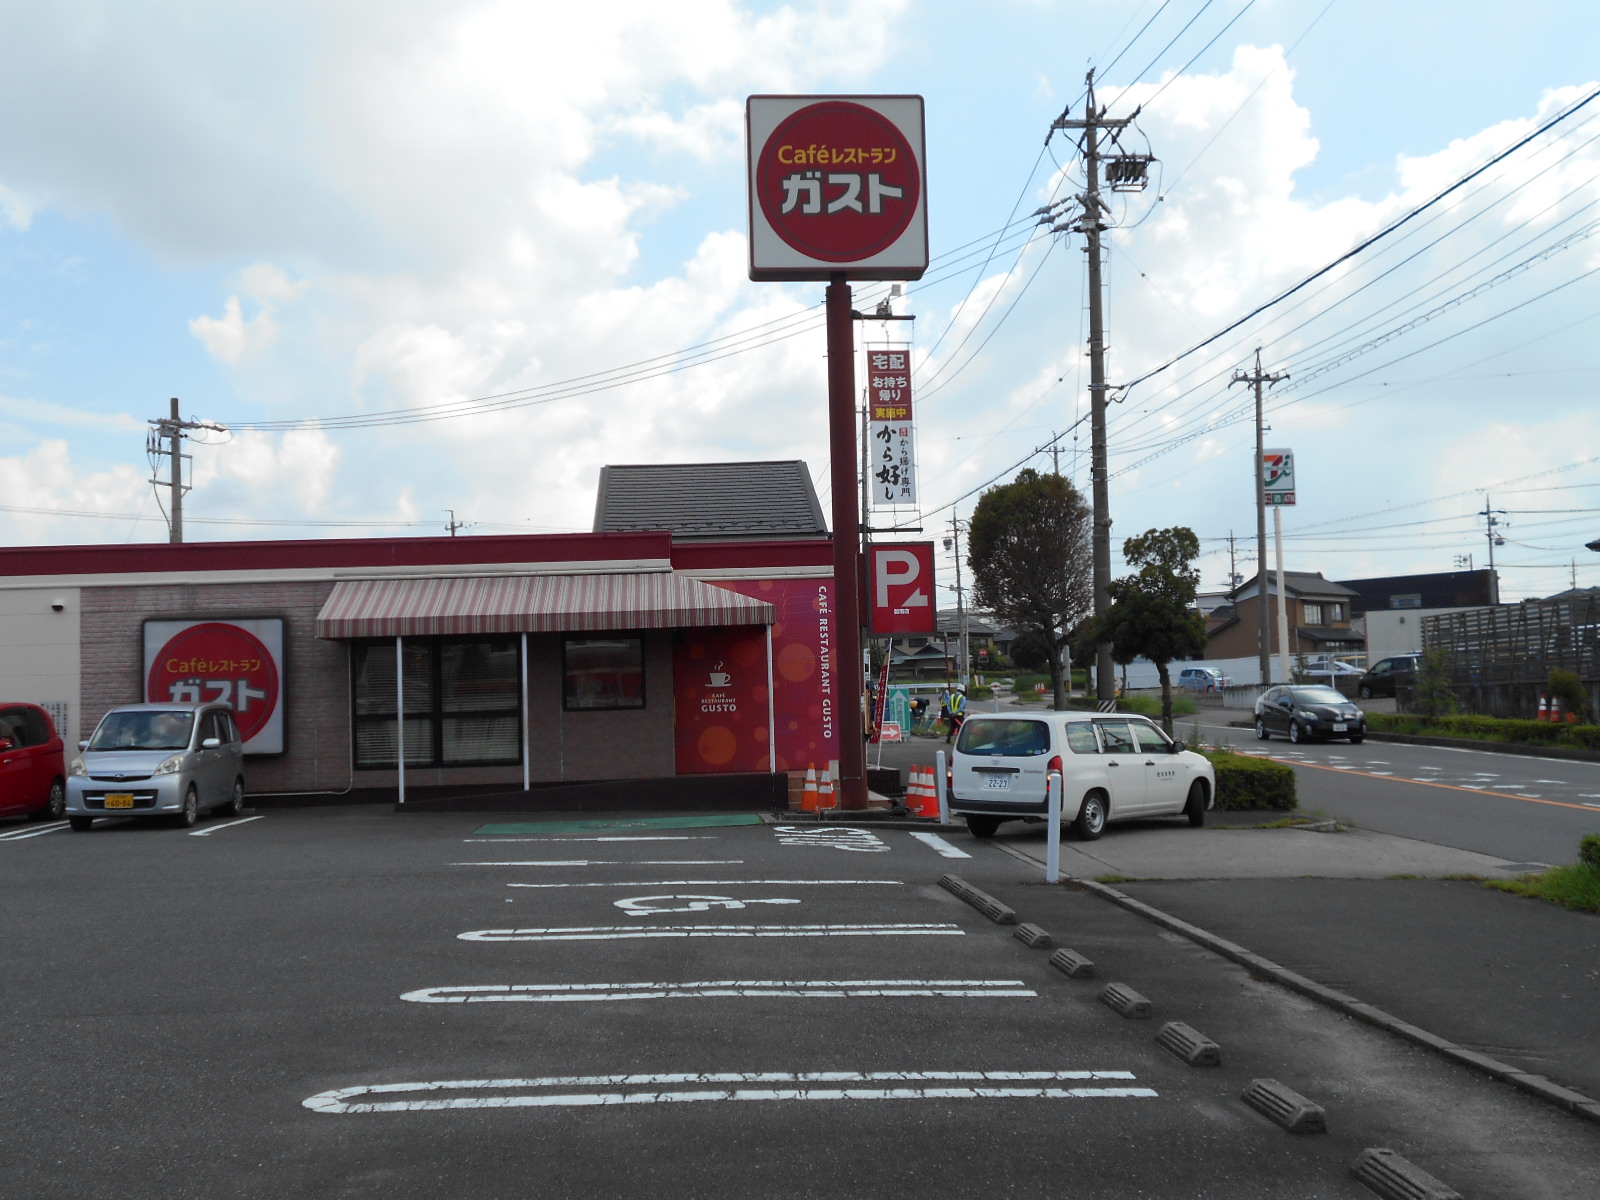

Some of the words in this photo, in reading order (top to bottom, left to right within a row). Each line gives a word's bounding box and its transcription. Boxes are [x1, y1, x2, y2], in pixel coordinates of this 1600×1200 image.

[778, 144, 896, 164] Caféレストラン
[781, 171, 902, 214] ガスト
[872, 354, 905, 370] 宅配
[872, 376, 907, 388] お持ち
[879, 389, 901, 401] 帰り
[875, 407, 906, 418] 実施中
[875, 424, 901, 501] から好し
[875, 550, 920, 608] P
[818, 585, 832, 614] CAFÉ
[819, 618, 831, 694] RESTAURANT
[165, 658, 261, 673] Caféレストラン
[701, 704, 737, 713] GUSTO
[822, 699, 832, 738] GUSTO
[988, 779, 1008, 788] 22-23
